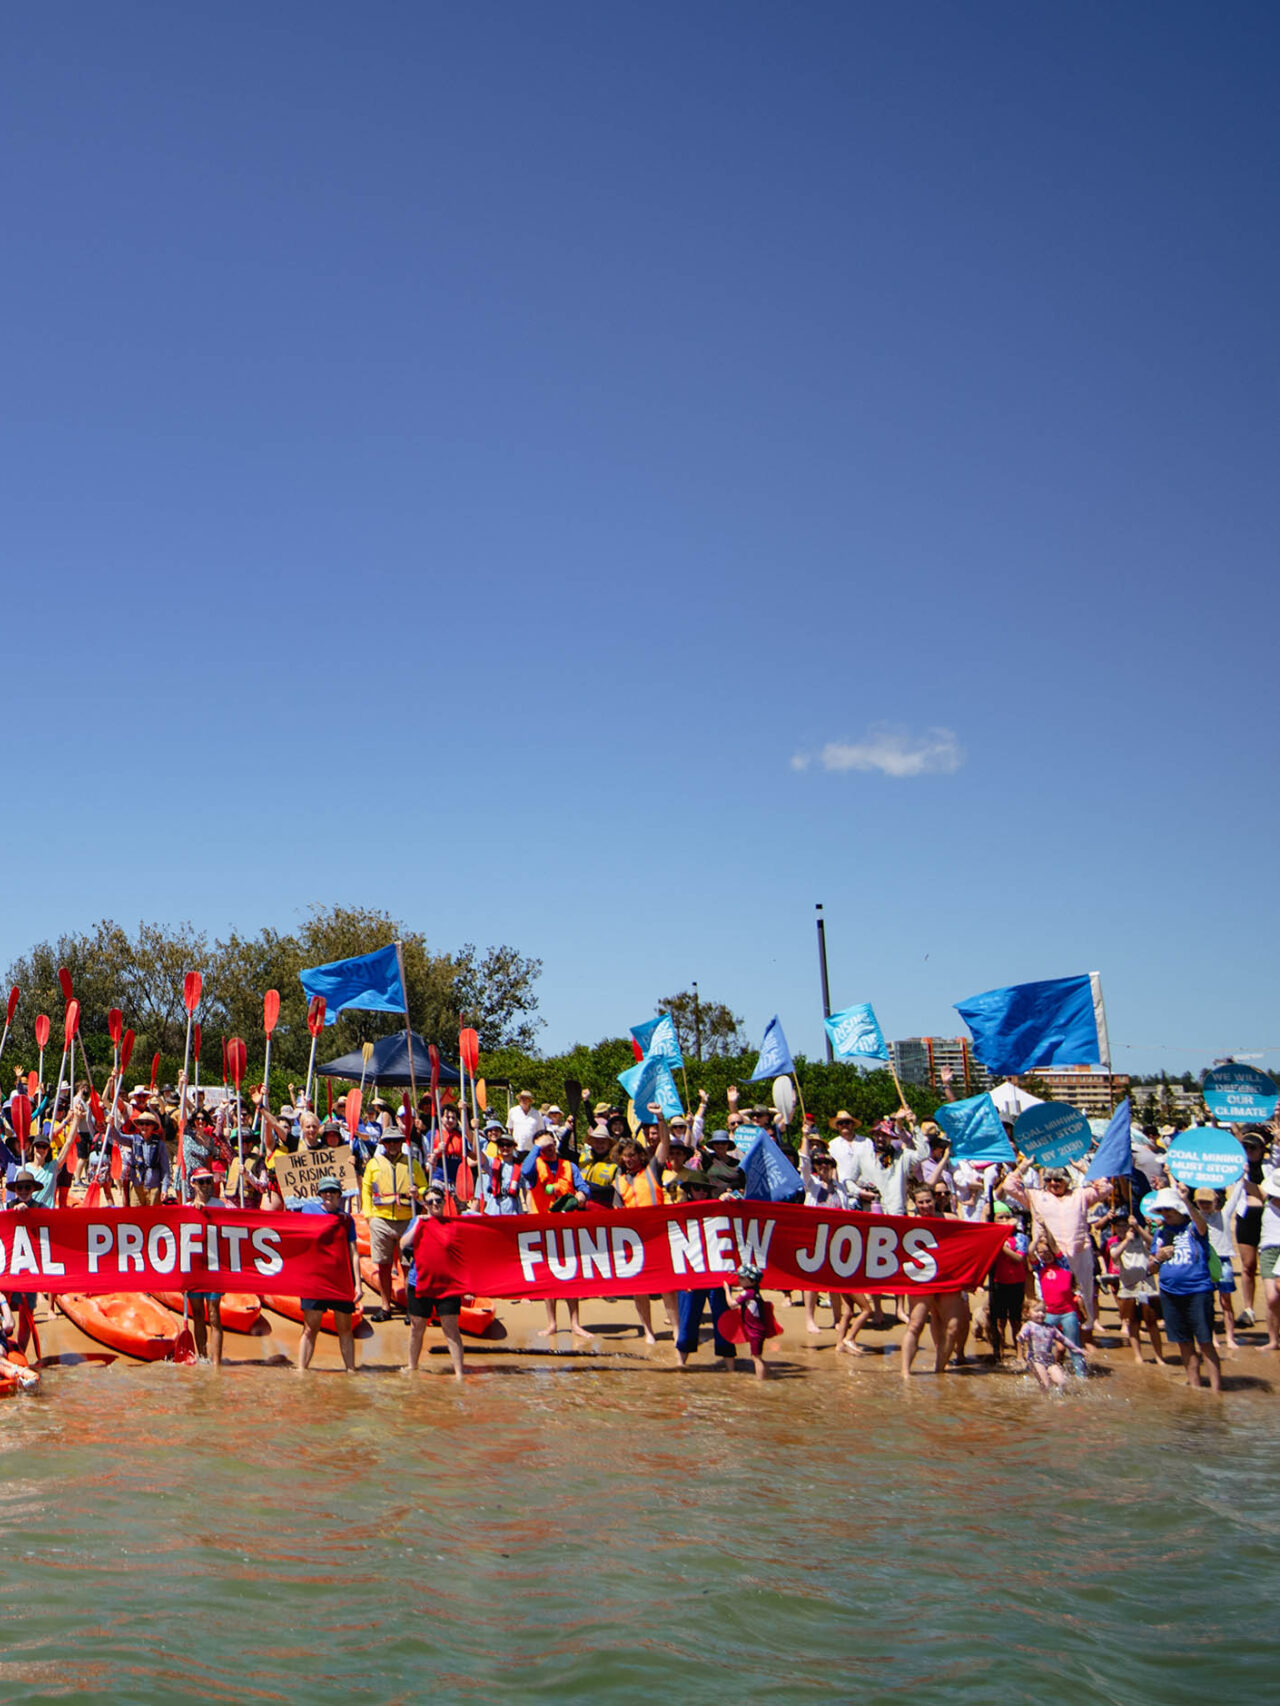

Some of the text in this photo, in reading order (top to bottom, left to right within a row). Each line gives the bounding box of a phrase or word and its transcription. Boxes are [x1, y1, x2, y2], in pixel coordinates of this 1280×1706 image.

[1212, 1073, 1263, 1082] WE WILL
[1227, 1094, 1254, 1105] OUR
[1214, 1106, 1268, 1117] CLIMATE
[1014, 1127, 1044, 1143] COAL
[1024, 1122, 1084, 1151] MUST STOP
[1041, 1140, 1084, 1162] BY 2030
[1168, 1149, 1245, 1164] COAL MINING
[288, 1150, 337, 1169] THE TIDE
[1171, 1160, 1238, 1173] MUST STOP
[284, 1165, 346, 1186] IS RISING &
[1177, 1171, 1194, 1179] BY
[293, 1184, 308, 1199] SO
[87, 1223, 284, 1276] PROFITS
[517, 1216, 940, 1283] FUND NEW JOBS
